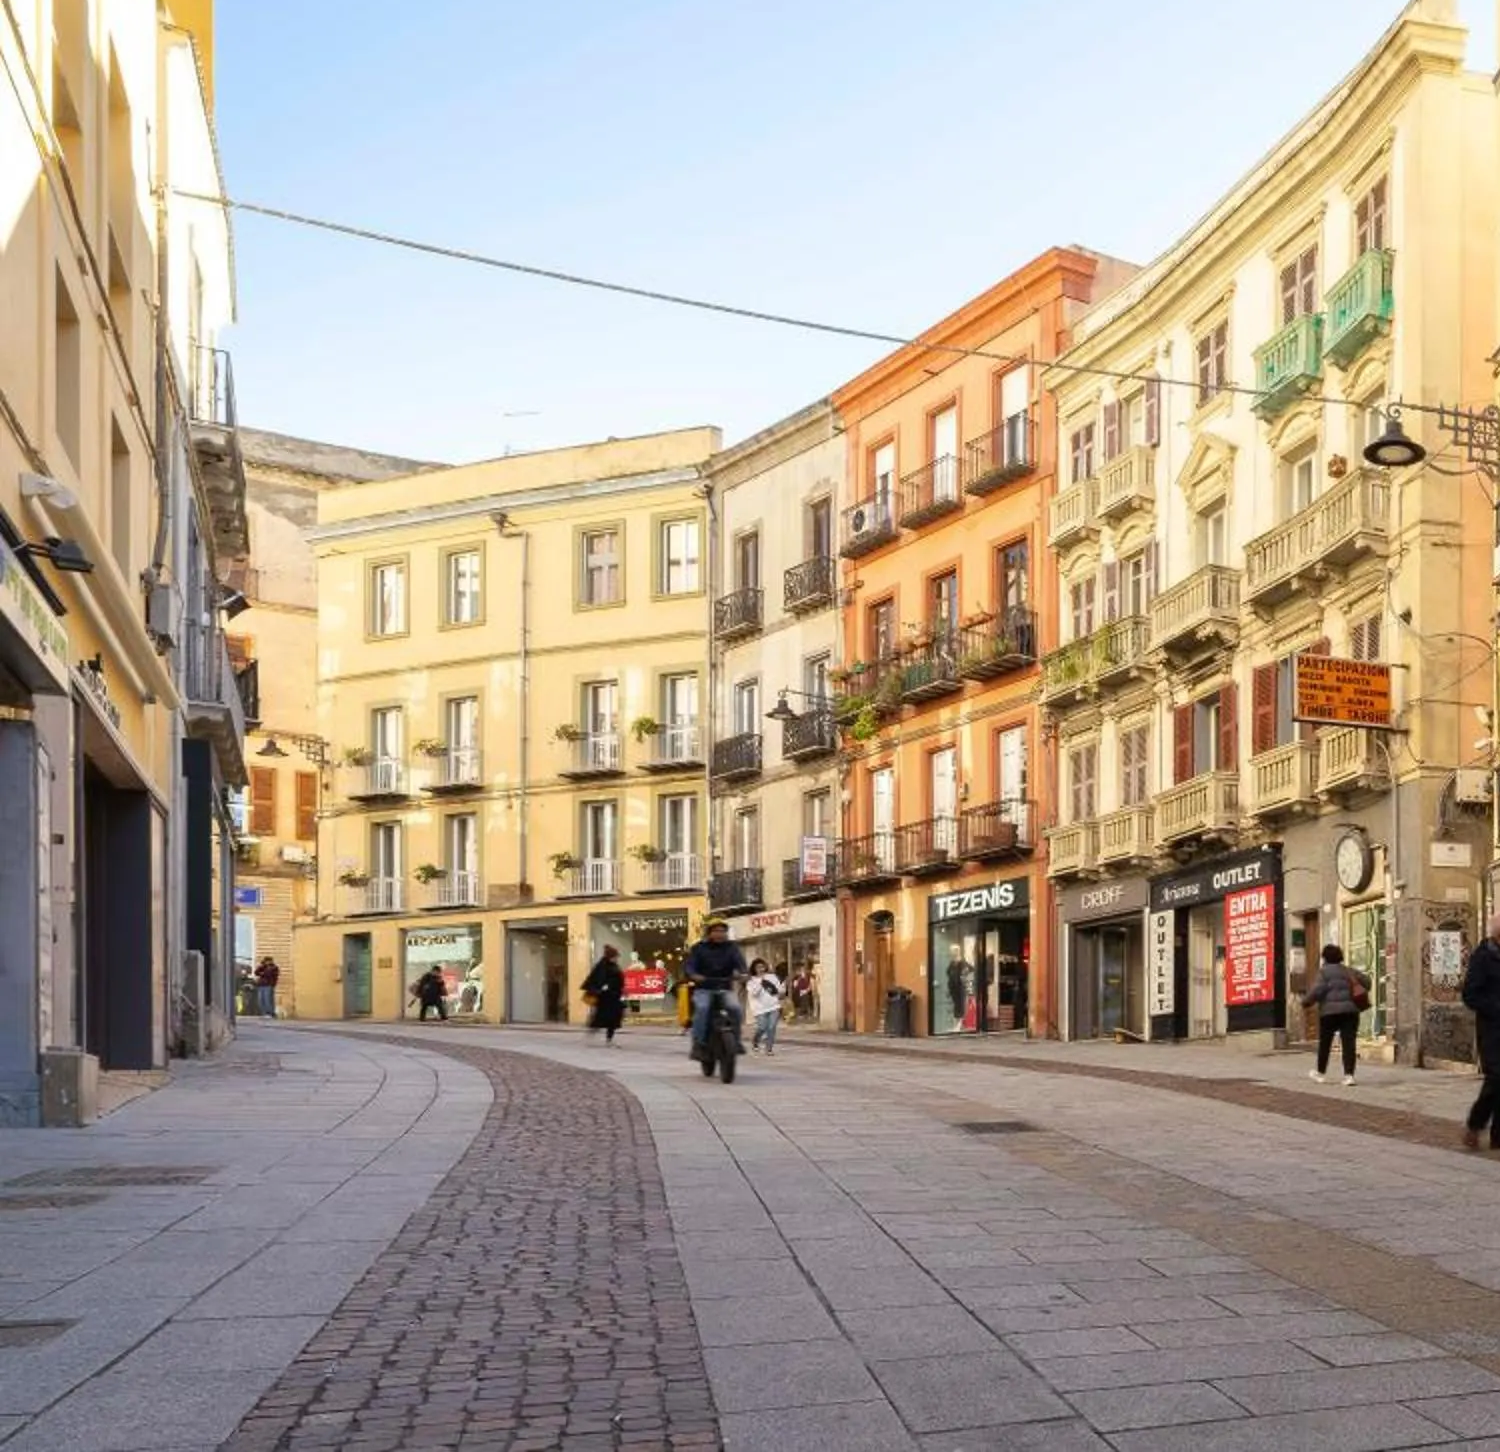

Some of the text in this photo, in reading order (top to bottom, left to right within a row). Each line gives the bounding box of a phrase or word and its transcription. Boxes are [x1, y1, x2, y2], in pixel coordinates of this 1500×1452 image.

[1297, 655, 1390, 677] PARTECIPAZIONI
[1213, 861, 1262, 890] OUTLET
[935, 883, 1015, 920] TEZENIS
[1229, 891, 1267, 917] ENTRA
[1156, 914, 1167, 1011] OUTLET
